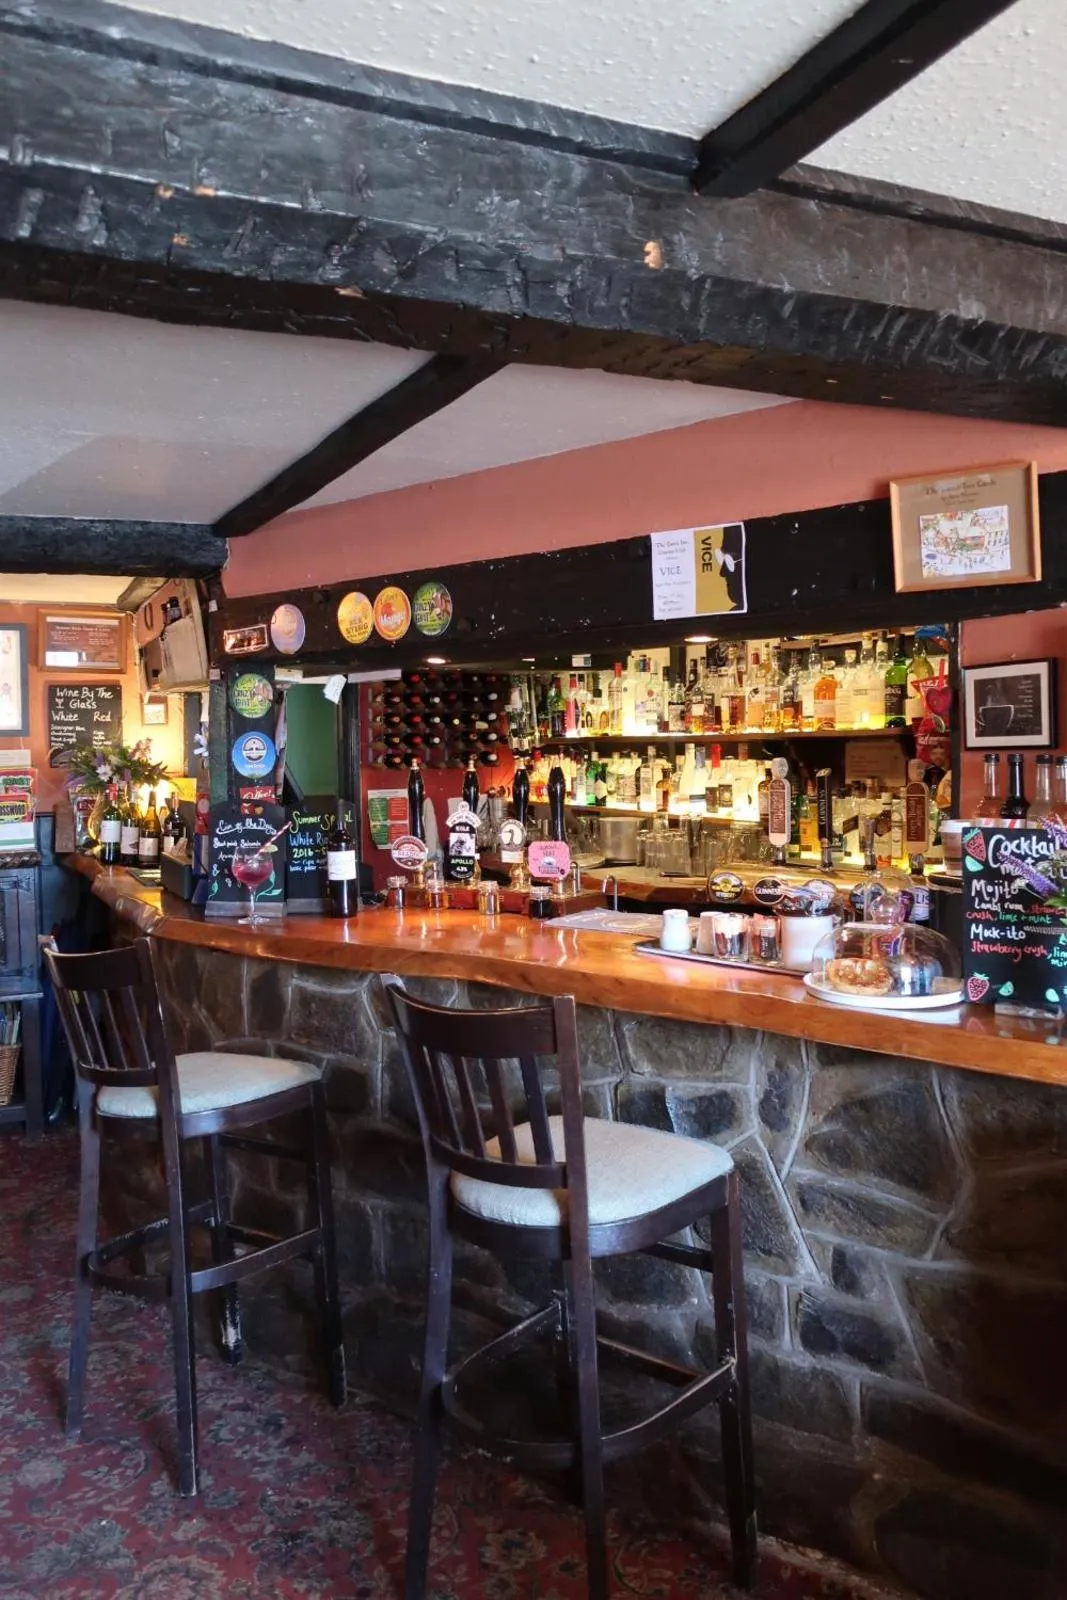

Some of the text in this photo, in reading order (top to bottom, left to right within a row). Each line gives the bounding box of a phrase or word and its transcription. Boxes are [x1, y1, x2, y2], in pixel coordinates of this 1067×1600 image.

[701, 536, 713, 573] VICE
[659, 566, 681, 576] VICE
[56, 687, 114, 700] Wine By The
[69, 698, 97, 709] Glass
[51, 710, 112, 722] White Red
[290, 811, 321, 833] Summer
[289, 832, 314, 845] White
[451, 858, 474, 866] APOLLO
[971, 879, 1019, 901] Mojito
[1029, 915, 1053, 923] mint
